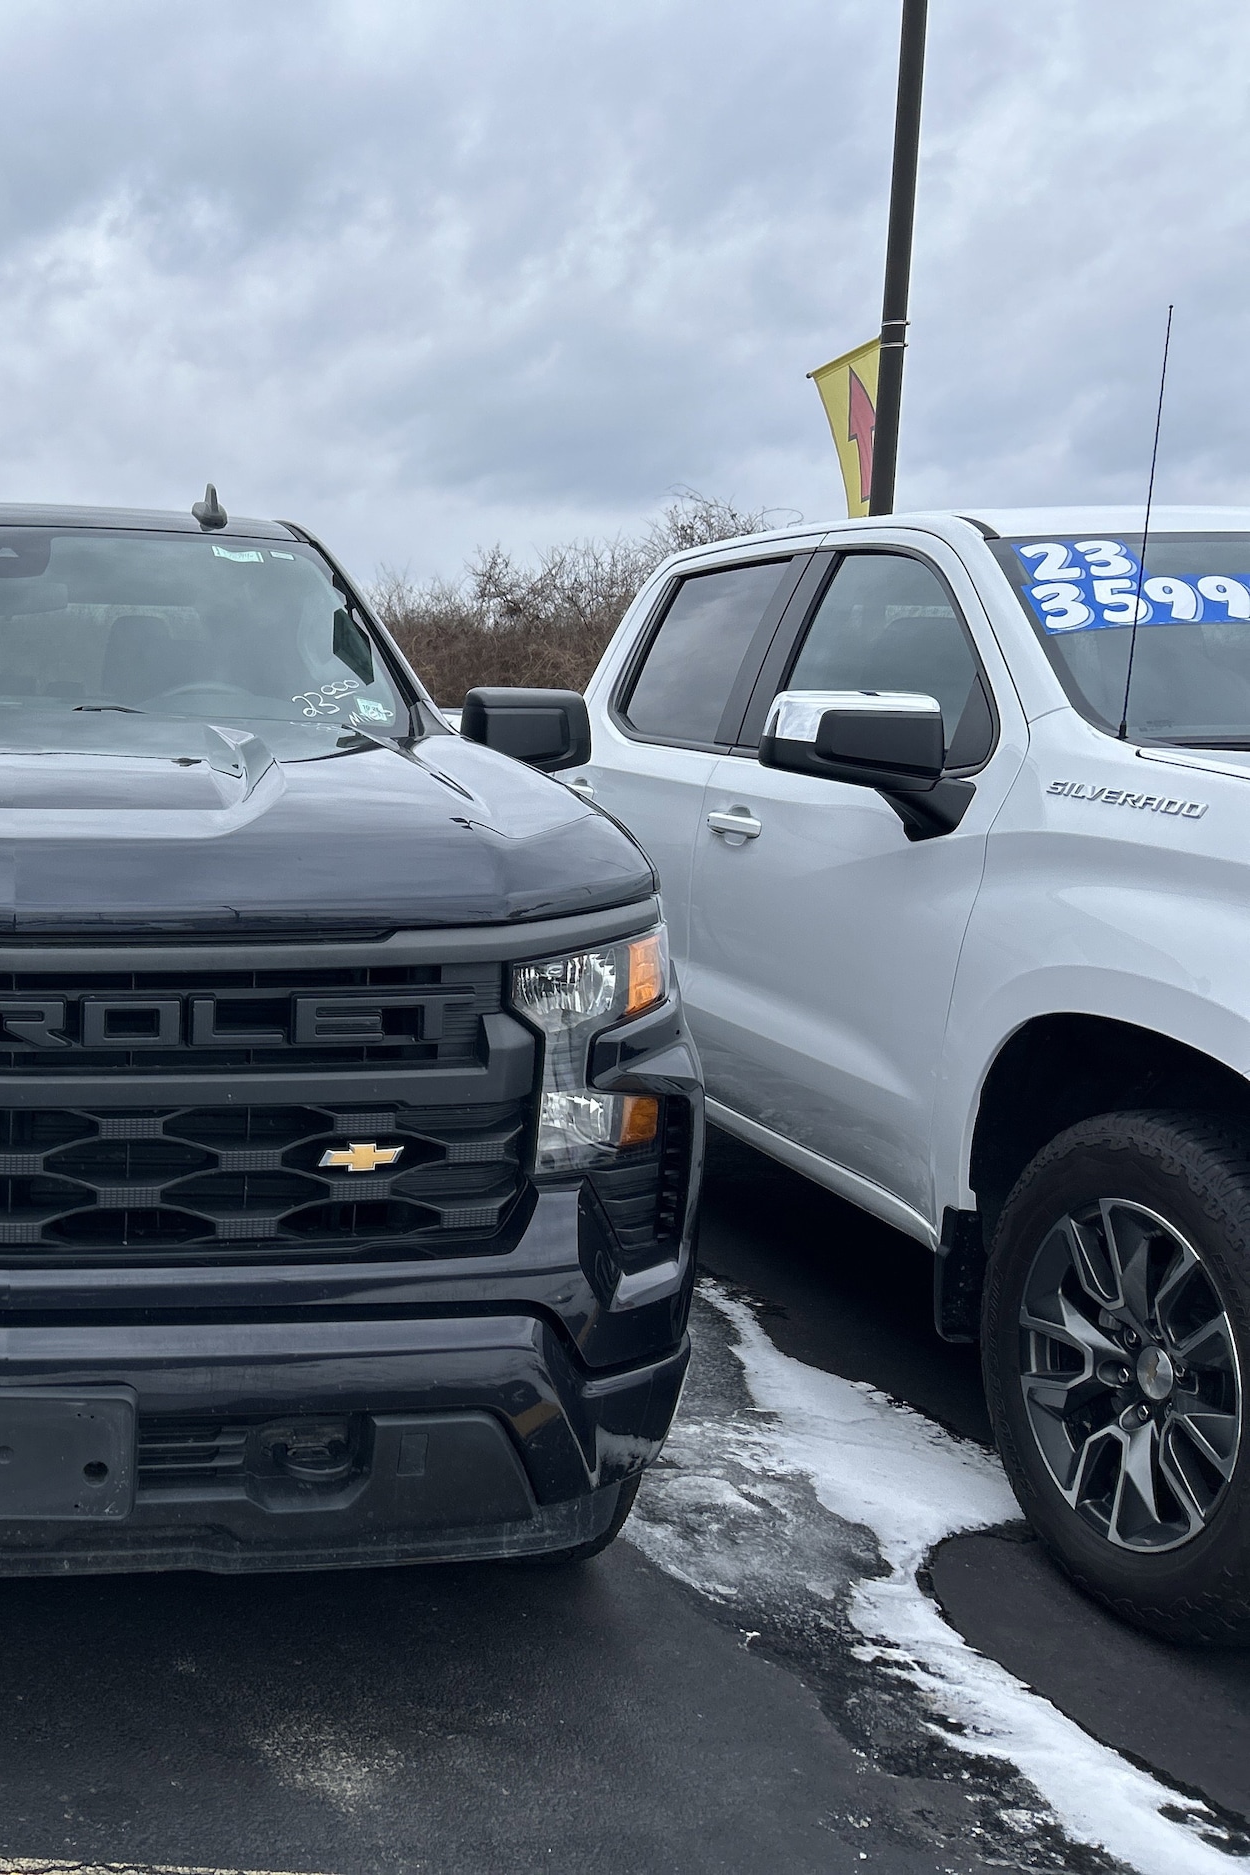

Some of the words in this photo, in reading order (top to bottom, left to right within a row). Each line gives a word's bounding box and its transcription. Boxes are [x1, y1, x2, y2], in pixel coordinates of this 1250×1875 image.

[1019, 540, 1137, 581] 23
[1031, 575, 1250, 630] 3599
[1046, 779, 1209, 819] SILVERADO
